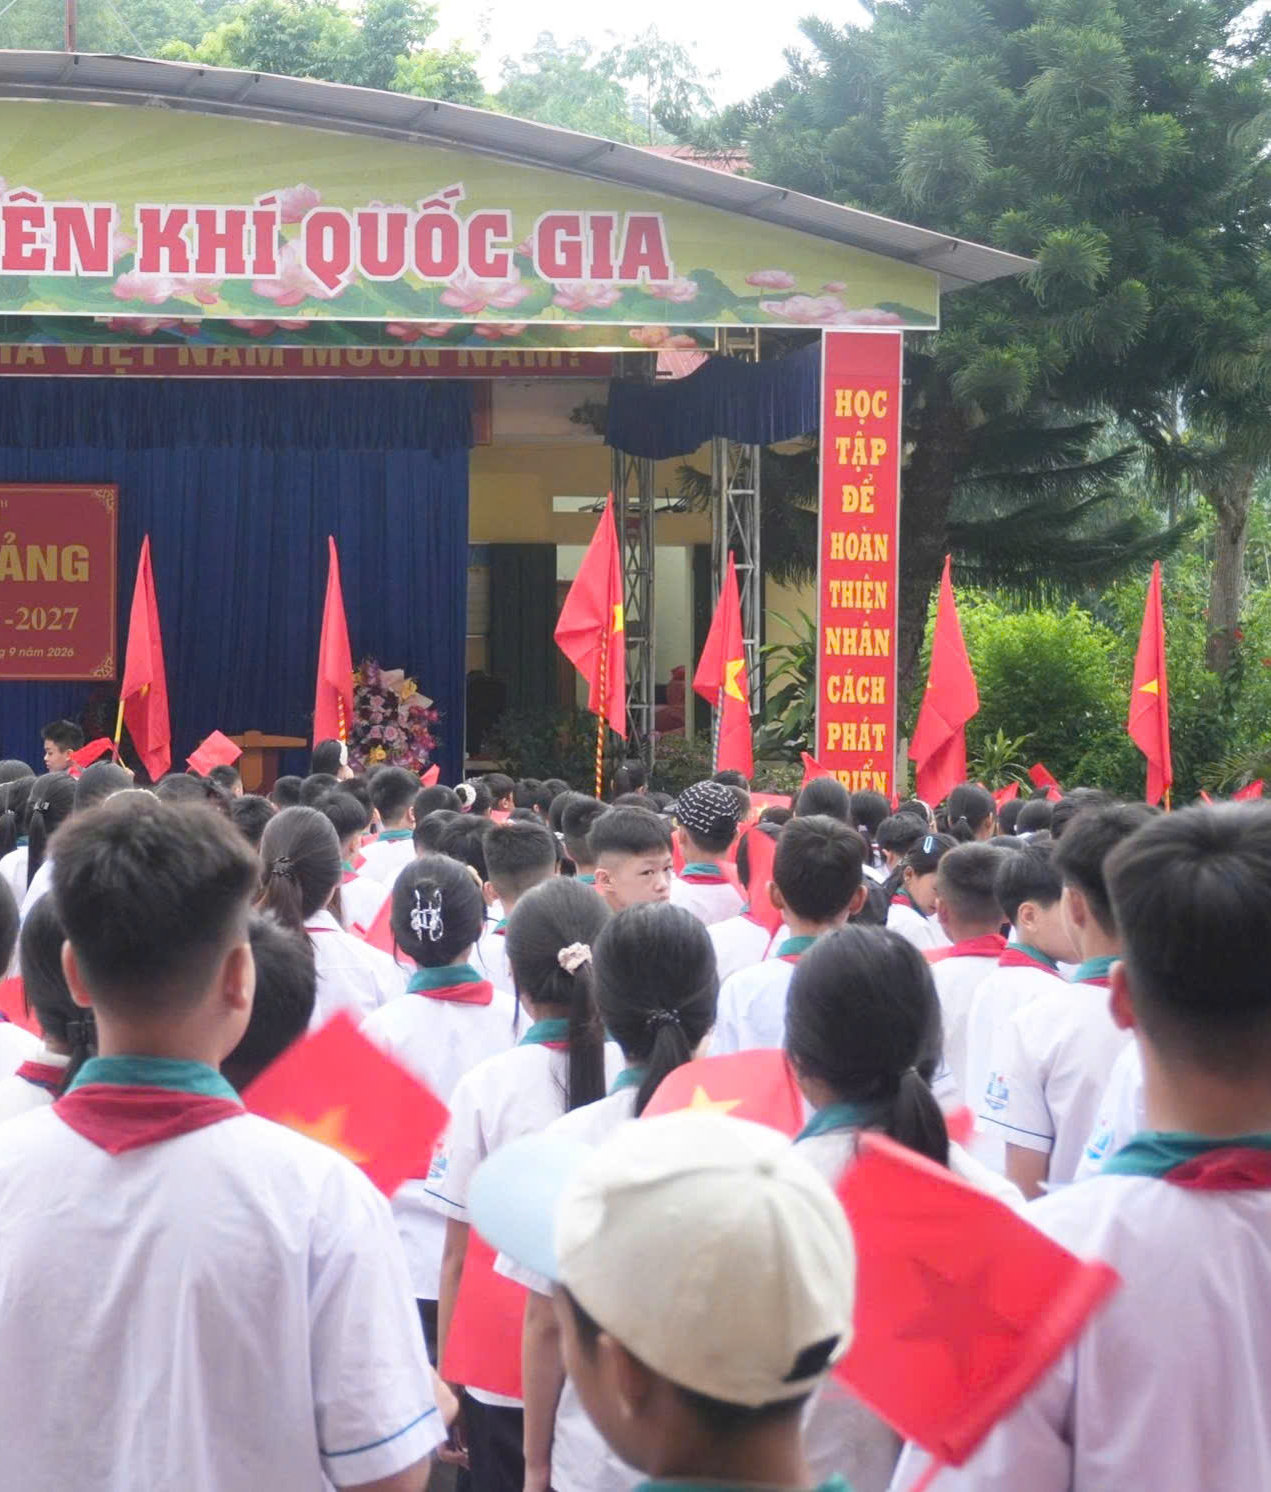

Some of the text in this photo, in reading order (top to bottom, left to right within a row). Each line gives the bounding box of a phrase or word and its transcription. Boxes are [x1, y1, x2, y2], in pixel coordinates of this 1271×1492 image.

[136, 192, 281, 278] KHÍ
[303, 184, 513, 296] QUỐC
[535, 211, 673, 283] GIA
[834, 389, 888, 425] HỌC
[835, 431, 887, 473] TẬP
[841, 474, 875, 513] ĐỂ
[830, 526, 889, 562] HOÀN
[829, 574, 888, 614] THIỆN
[4, 606, 79, 631] -2027
[8, 647, 16, 657] 9
[46, 647, 75, 657] 2026
[825, 621, 890, 656] NHÂN
[827, 669, 886, 704] CÁCH
[826, 716, 886, 751] PHÁT
